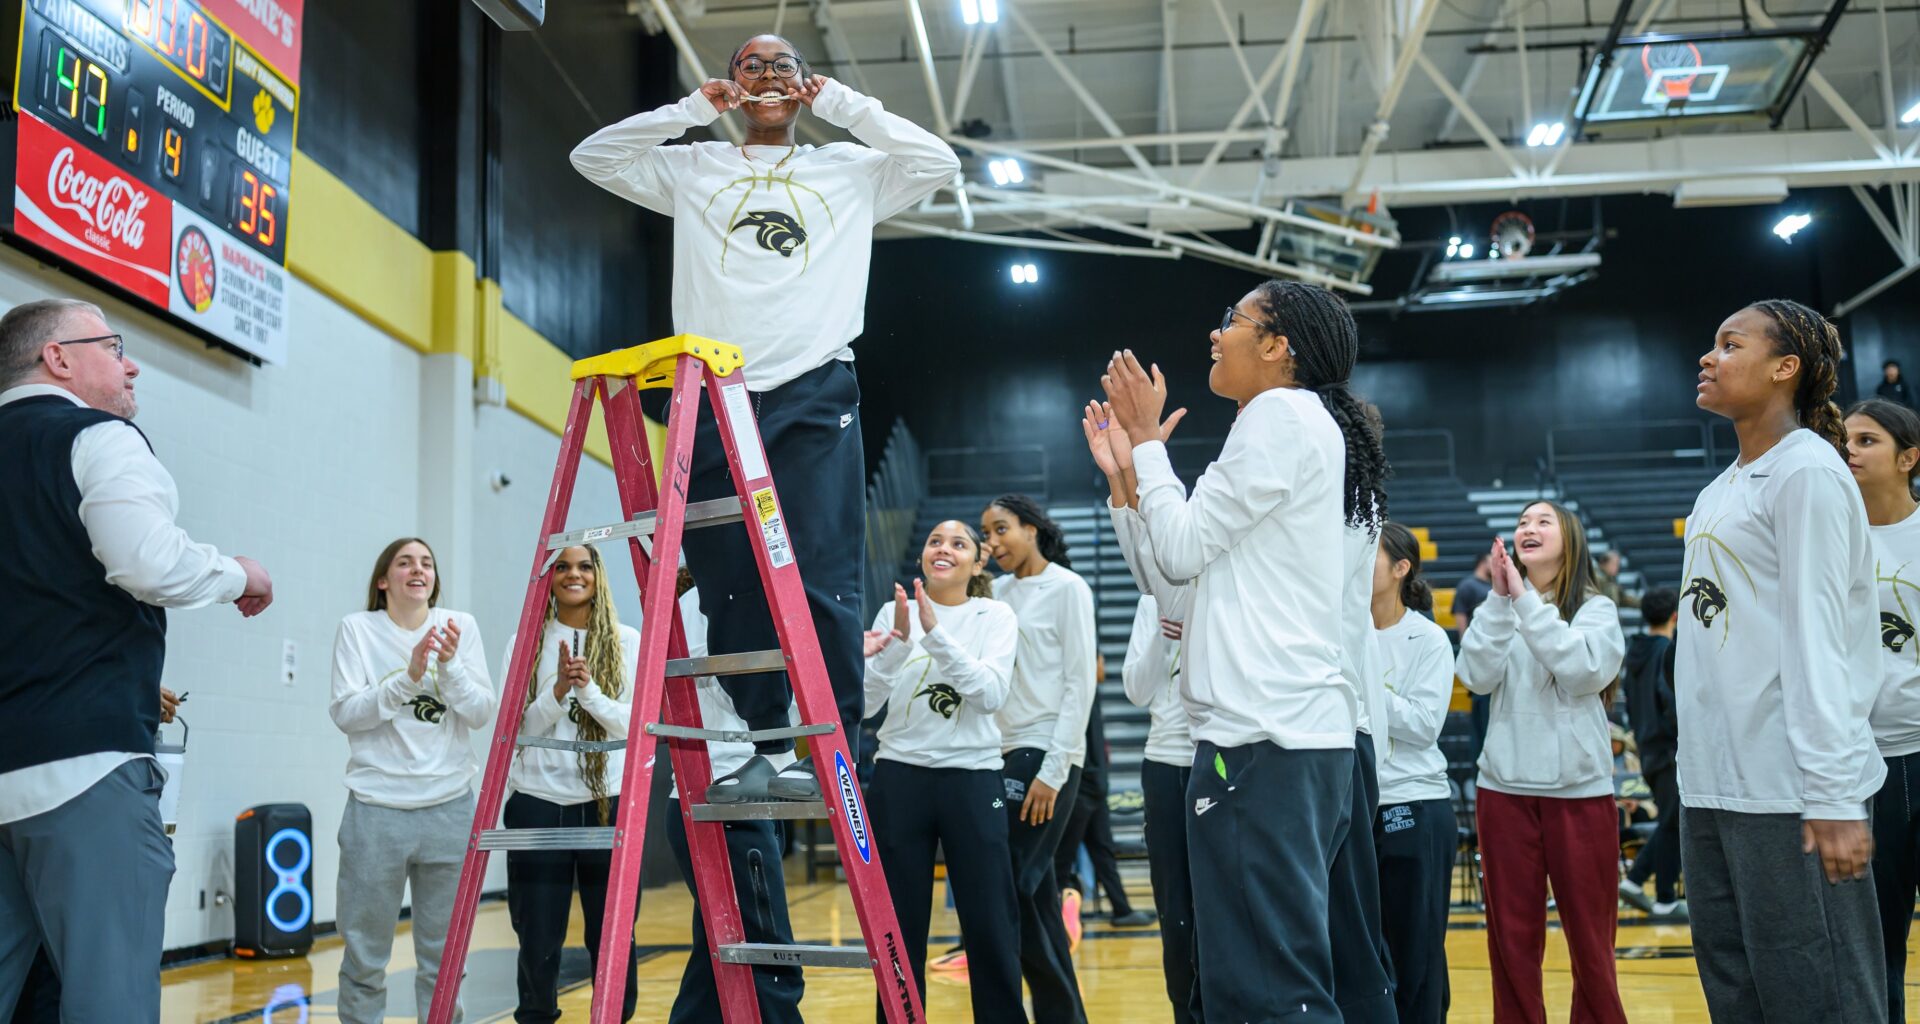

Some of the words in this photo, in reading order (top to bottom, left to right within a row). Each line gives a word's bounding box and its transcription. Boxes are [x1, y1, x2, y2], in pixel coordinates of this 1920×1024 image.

[57, 47, 108, 135] 47
[156, 85, 195, 129] PERIOD
[165, 128, 182, 177] 4
[236, 126, 280, 179] GUEST
[48, 146, 150, 250] Coca-Cola
[239, 171, 276, 247] 35
[85, 227, 111, 251] classic
[841, 773, 864, 841] WERNER
